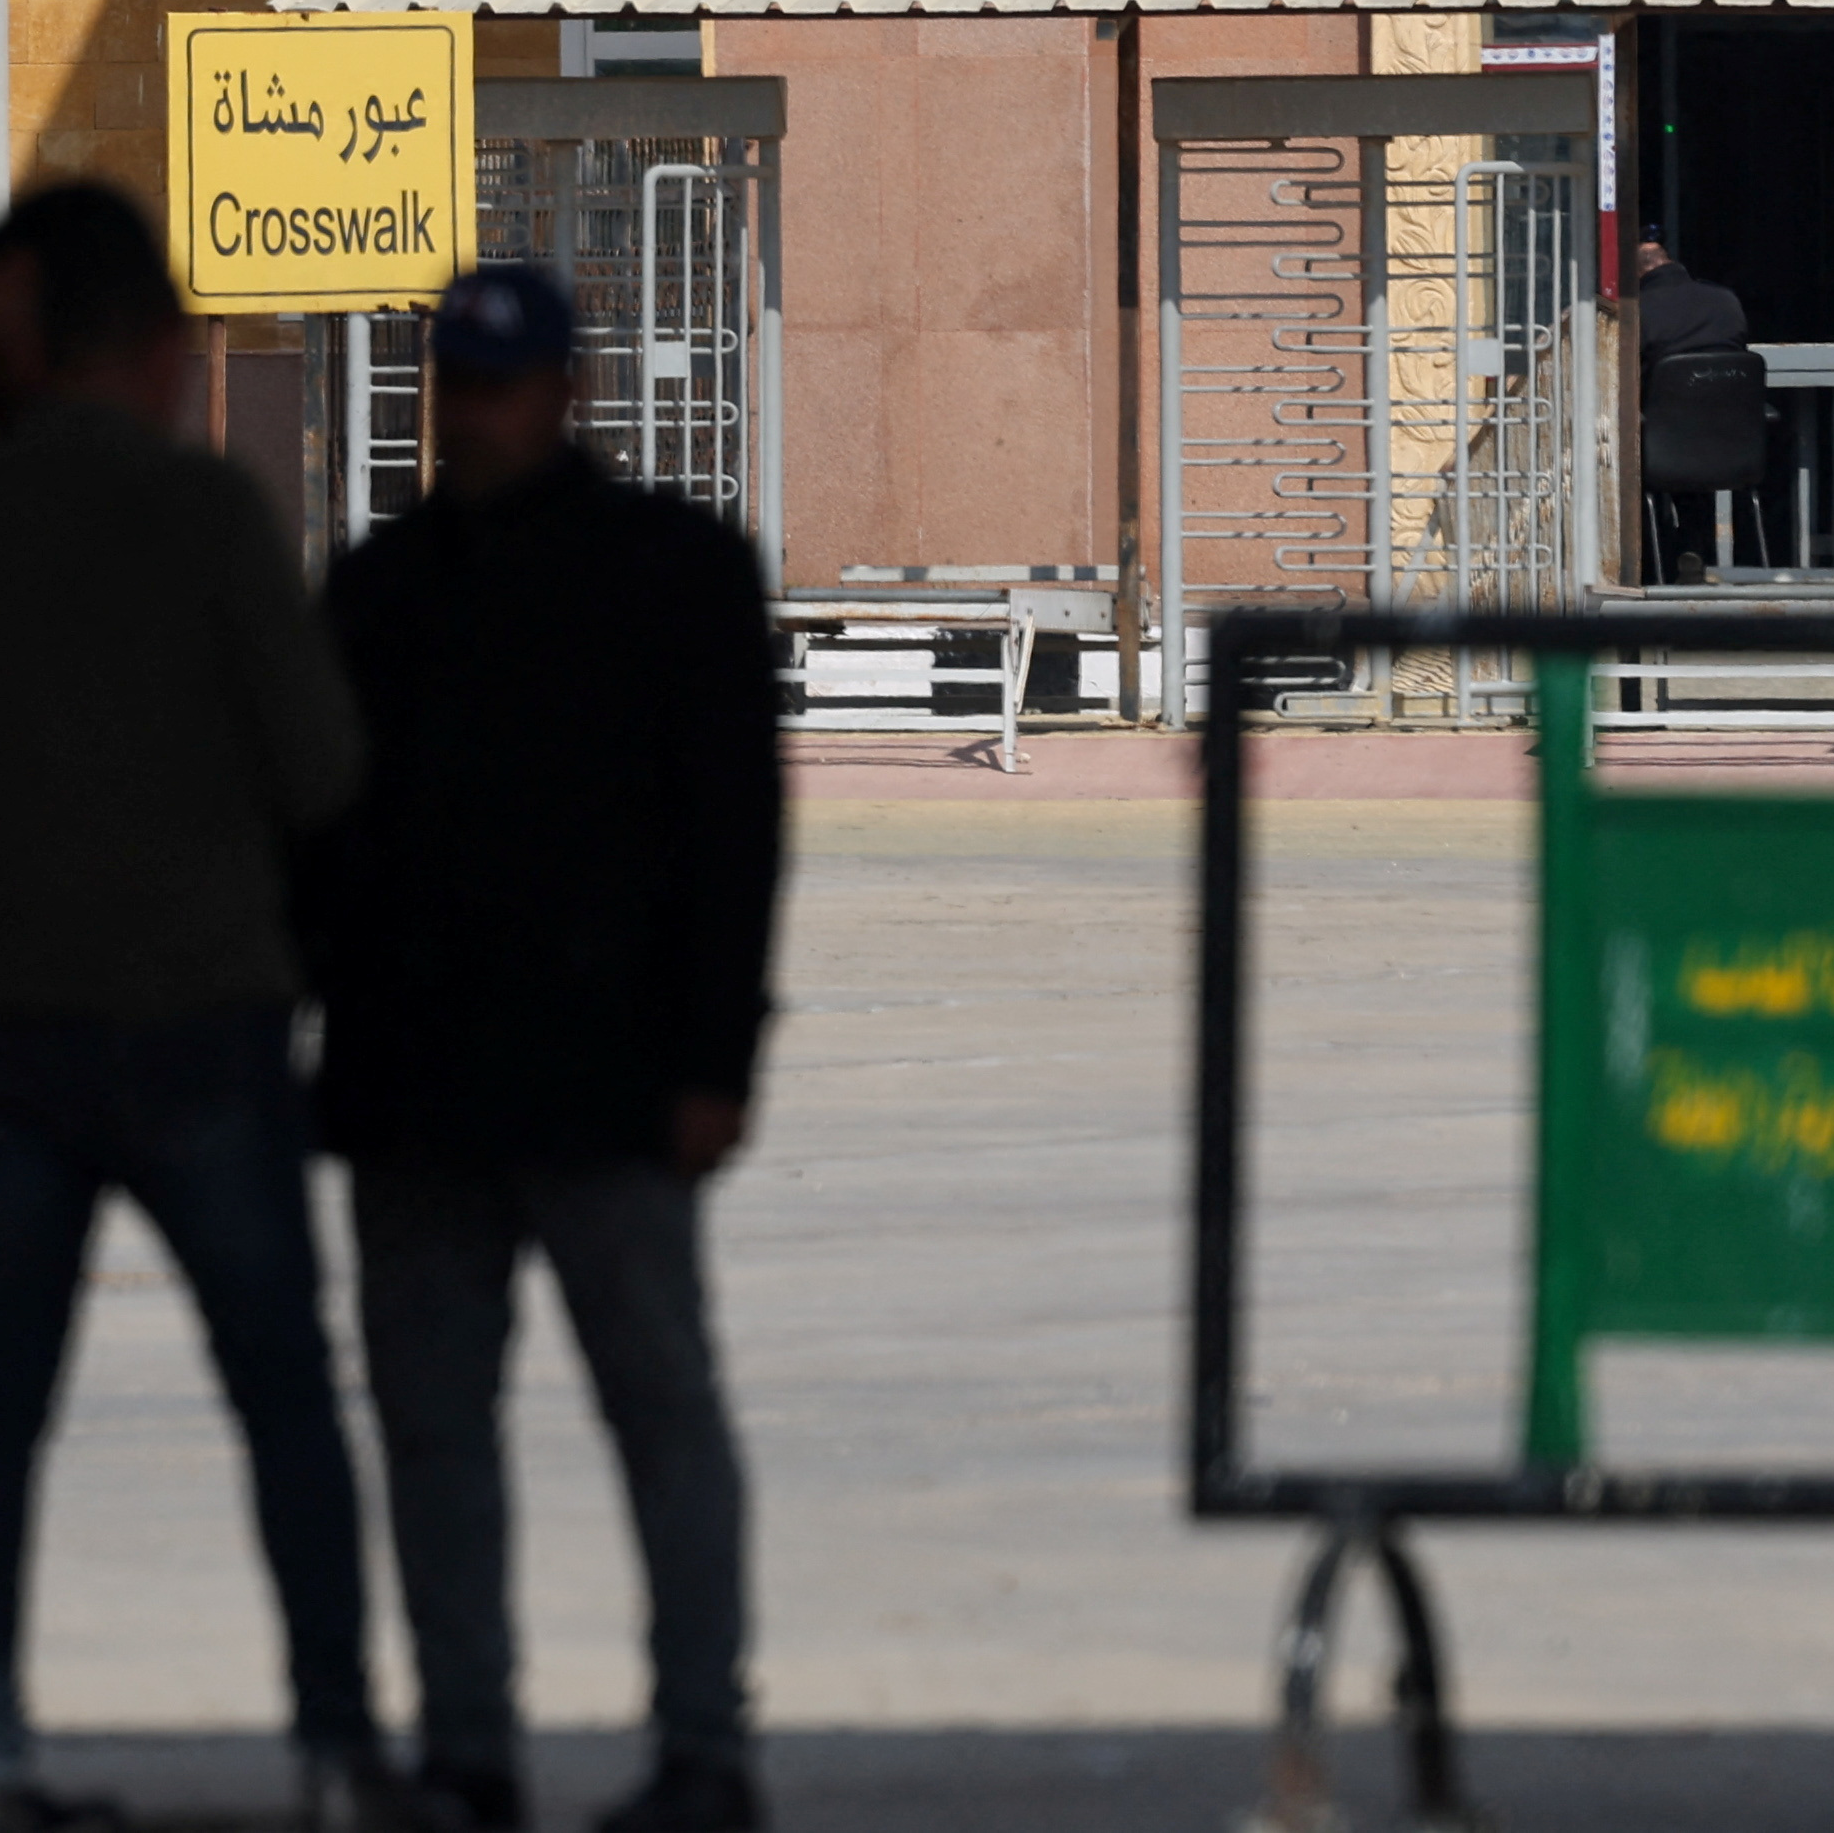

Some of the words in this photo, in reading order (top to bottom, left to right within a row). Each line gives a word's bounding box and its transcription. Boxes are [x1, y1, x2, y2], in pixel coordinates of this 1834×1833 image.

[213, 69, 325, 141] مشاة
[338, 87, 427, 164] عبور
[209, 189, 437, 257] Crosswalk
